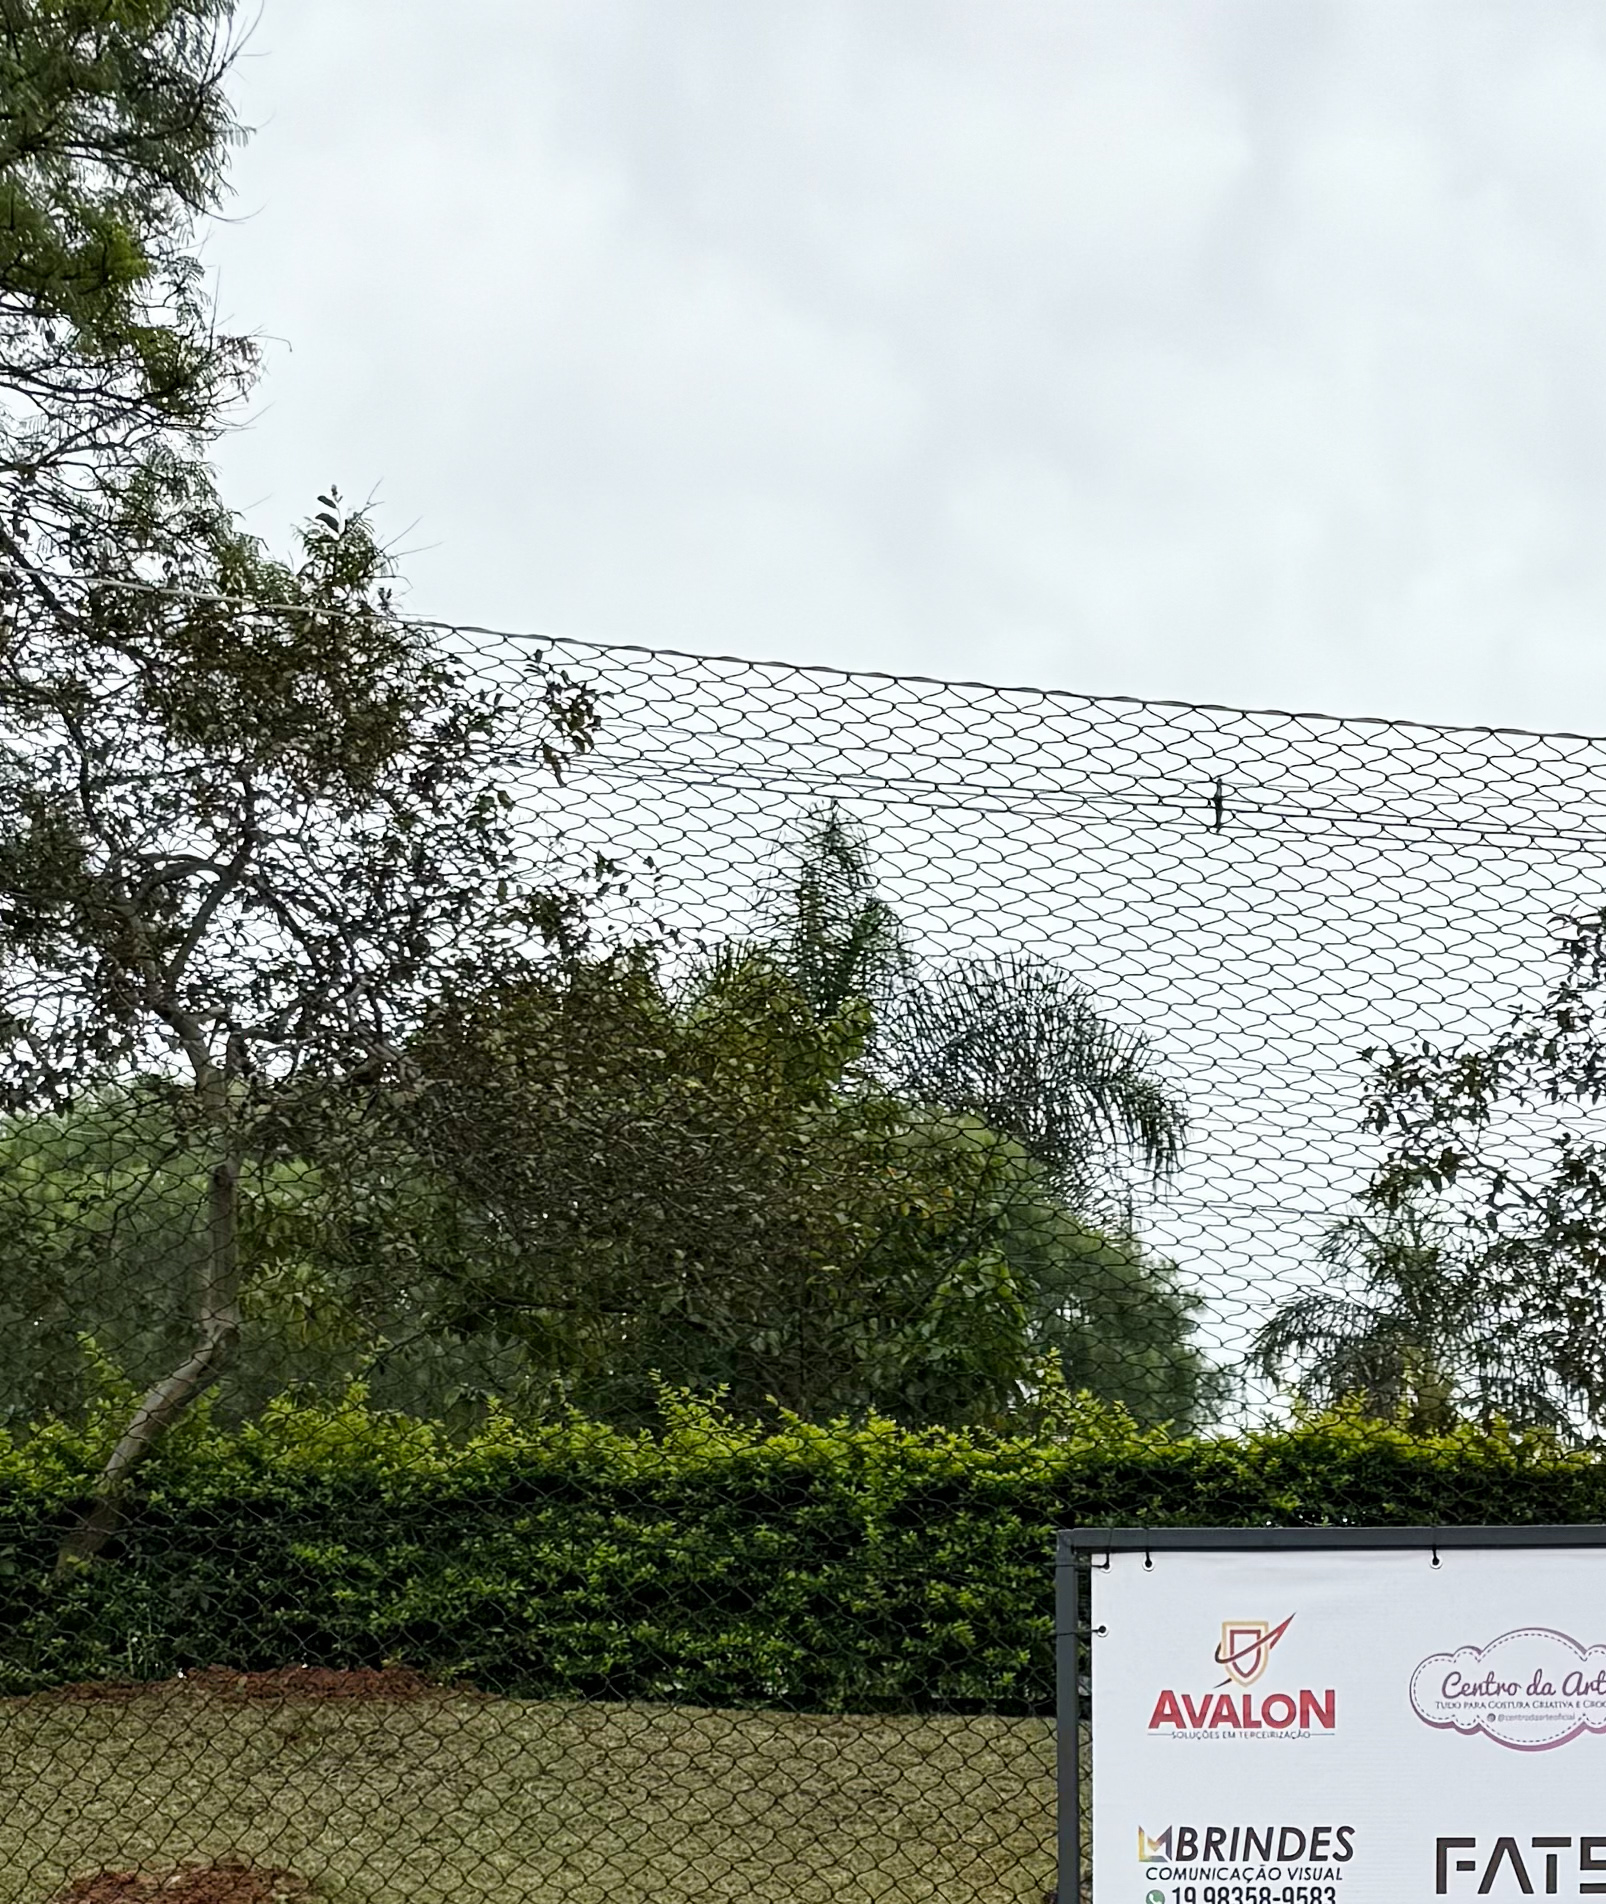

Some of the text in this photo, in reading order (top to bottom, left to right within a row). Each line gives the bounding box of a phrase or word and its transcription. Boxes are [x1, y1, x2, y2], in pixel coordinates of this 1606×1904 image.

[1441, 1671, 1522, 1699] Centro
[1526, 1668, 1556, 1696] da
[1148, 1689, 1336, 1729] AVALON
[1171, 1730, 1220, 1740] SOLUÇÕES
[1222, 1731, 1236, 1739] EM
[1145, 1864, 1344, 1884] COMUNICAÇÃO VISUAL
